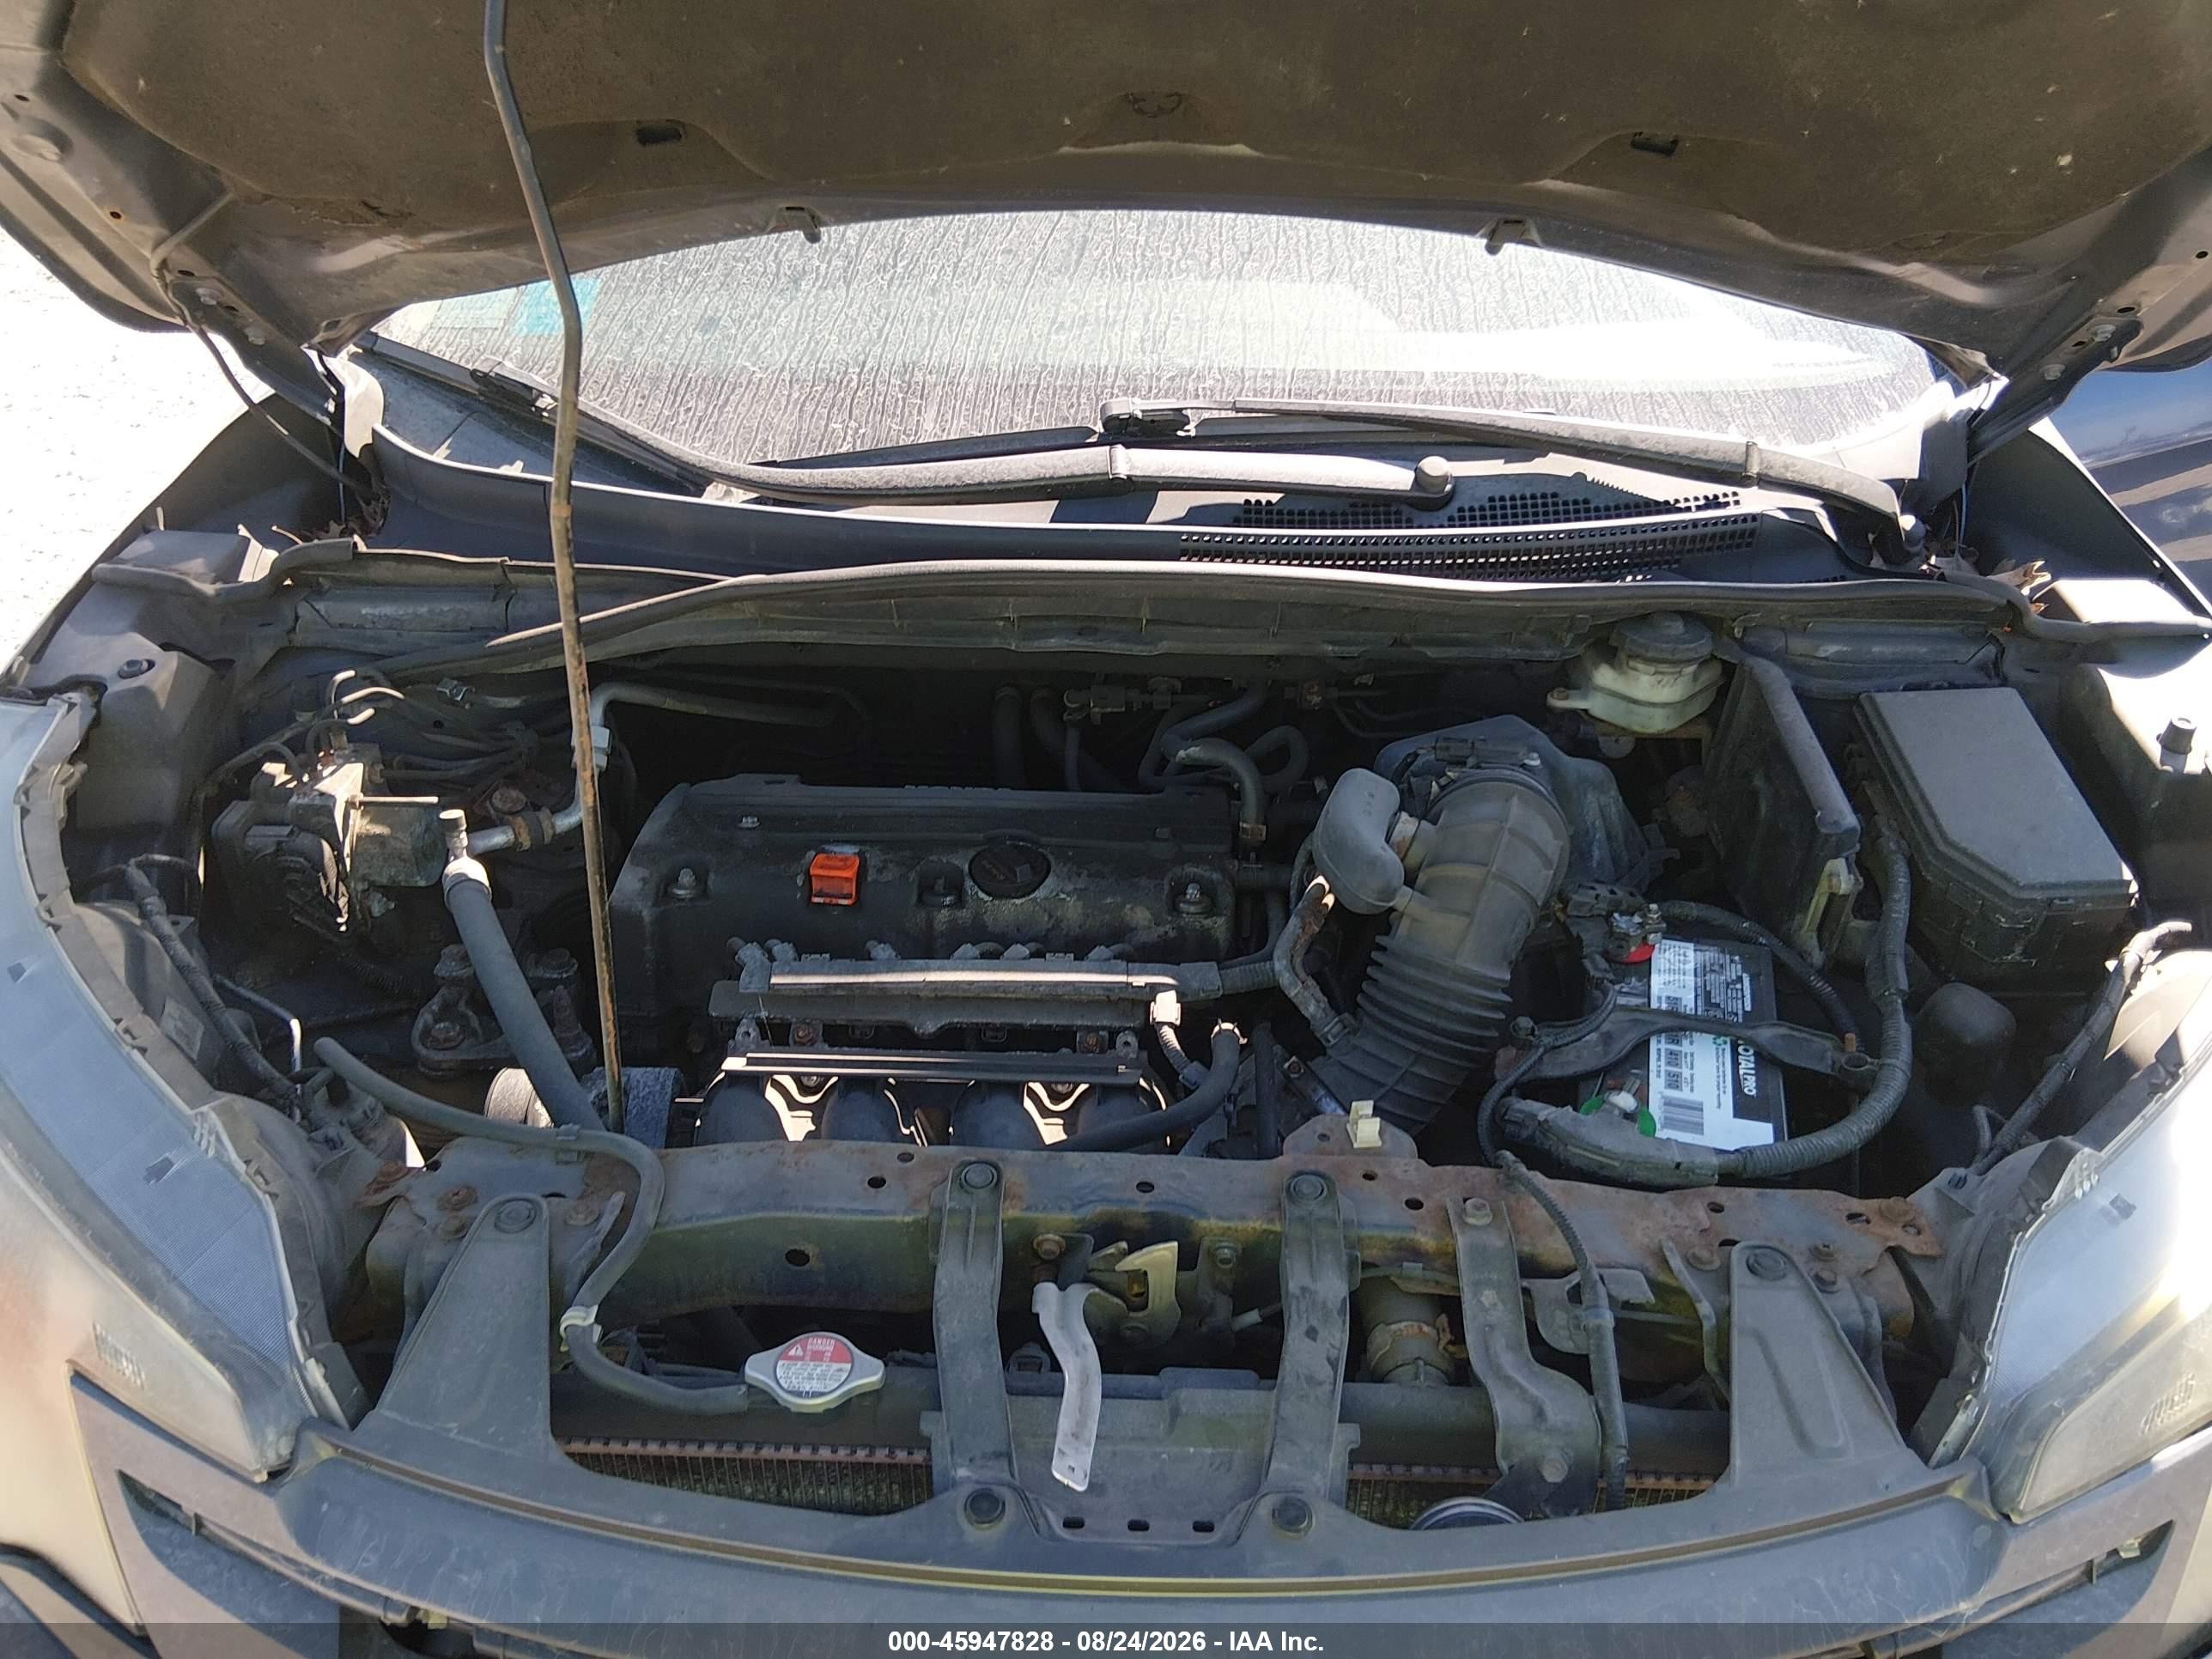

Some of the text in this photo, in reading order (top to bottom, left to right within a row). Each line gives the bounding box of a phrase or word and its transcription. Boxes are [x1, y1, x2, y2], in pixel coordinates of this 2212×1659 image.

[1667, 1050, 1679, 1067] 410
[1736, 1039, 1757, 1097] OTALPRO
[1667, 1072, 1679, 1090] 510
